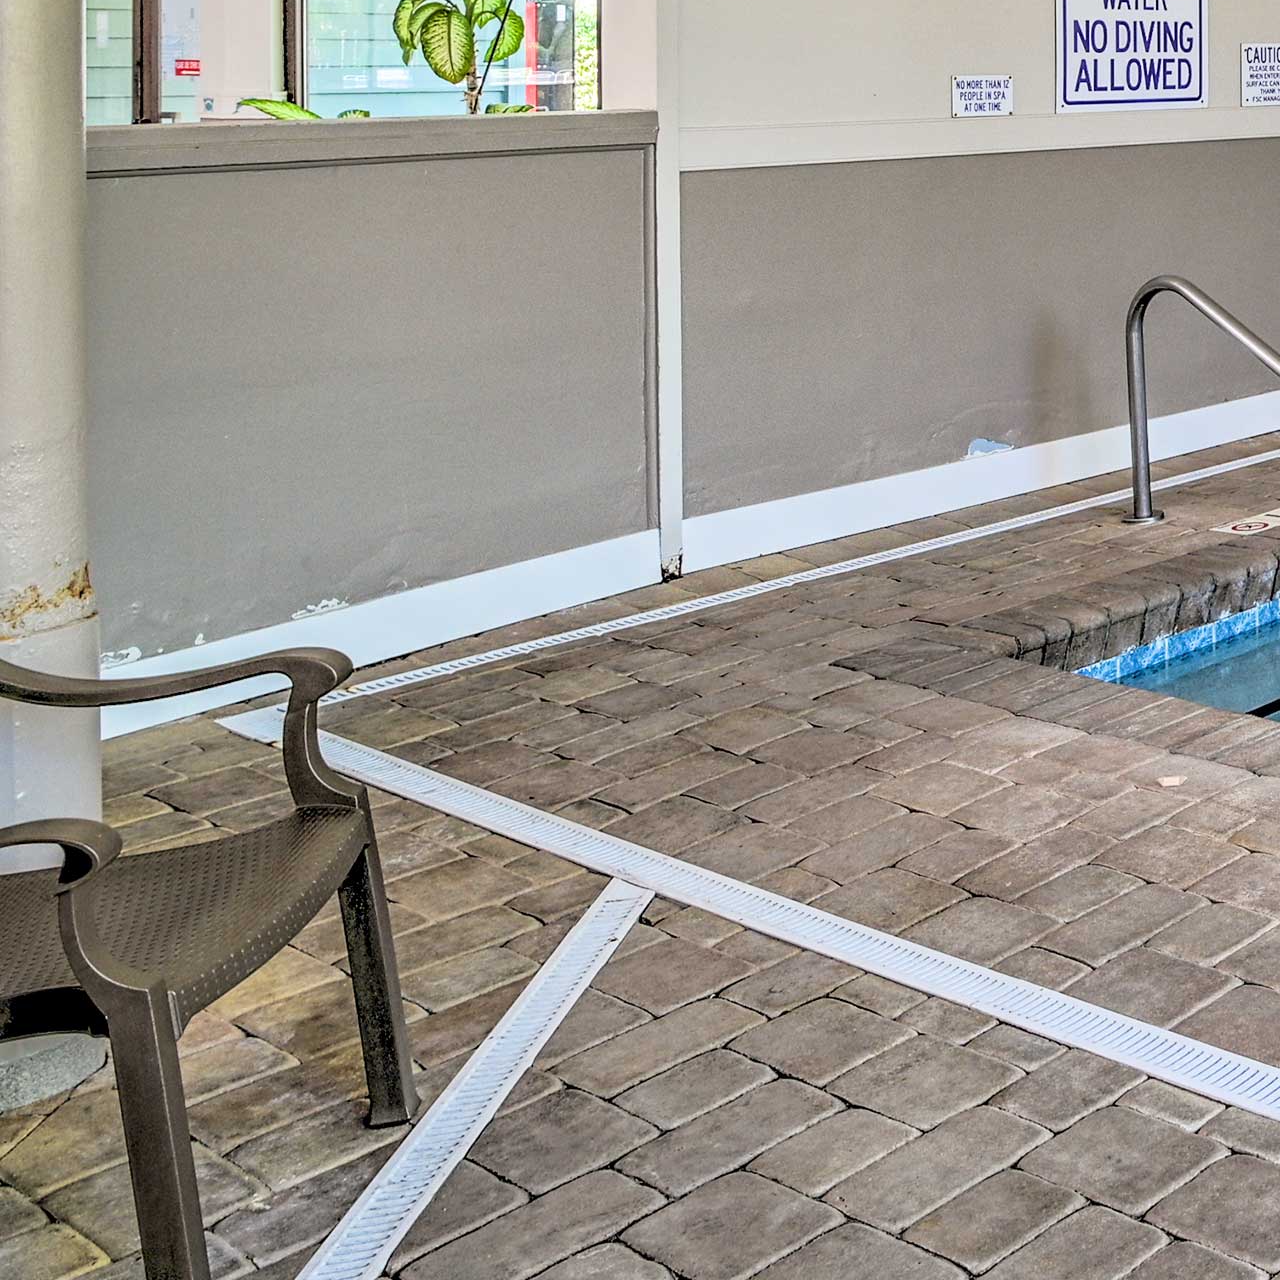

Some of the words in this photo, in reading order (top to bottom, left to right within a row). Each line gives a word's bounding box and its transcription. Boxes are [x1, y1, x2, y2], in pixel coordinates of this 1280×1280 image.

[1074, 21, 1107, 53] NO
[1115, 21, 1193, 53] DIVING
[1075, 58, 1192, 91] ALLOWED
[956, 81, 965, 89] NO
[966, 80, 982, 89] MORE
[985, 80, 1001, 89] THAN
[1003, 80, 1009, 88] 12
[960, 92, 982, 100] PEOPLE
[984, 91, 991, 100] IN
[993, 91, 1006, 100] SPA
[964, 104, 971, 112] AT
[973, 103, 986, 112] ONE
[988, 103, 1001, 111] TIME
